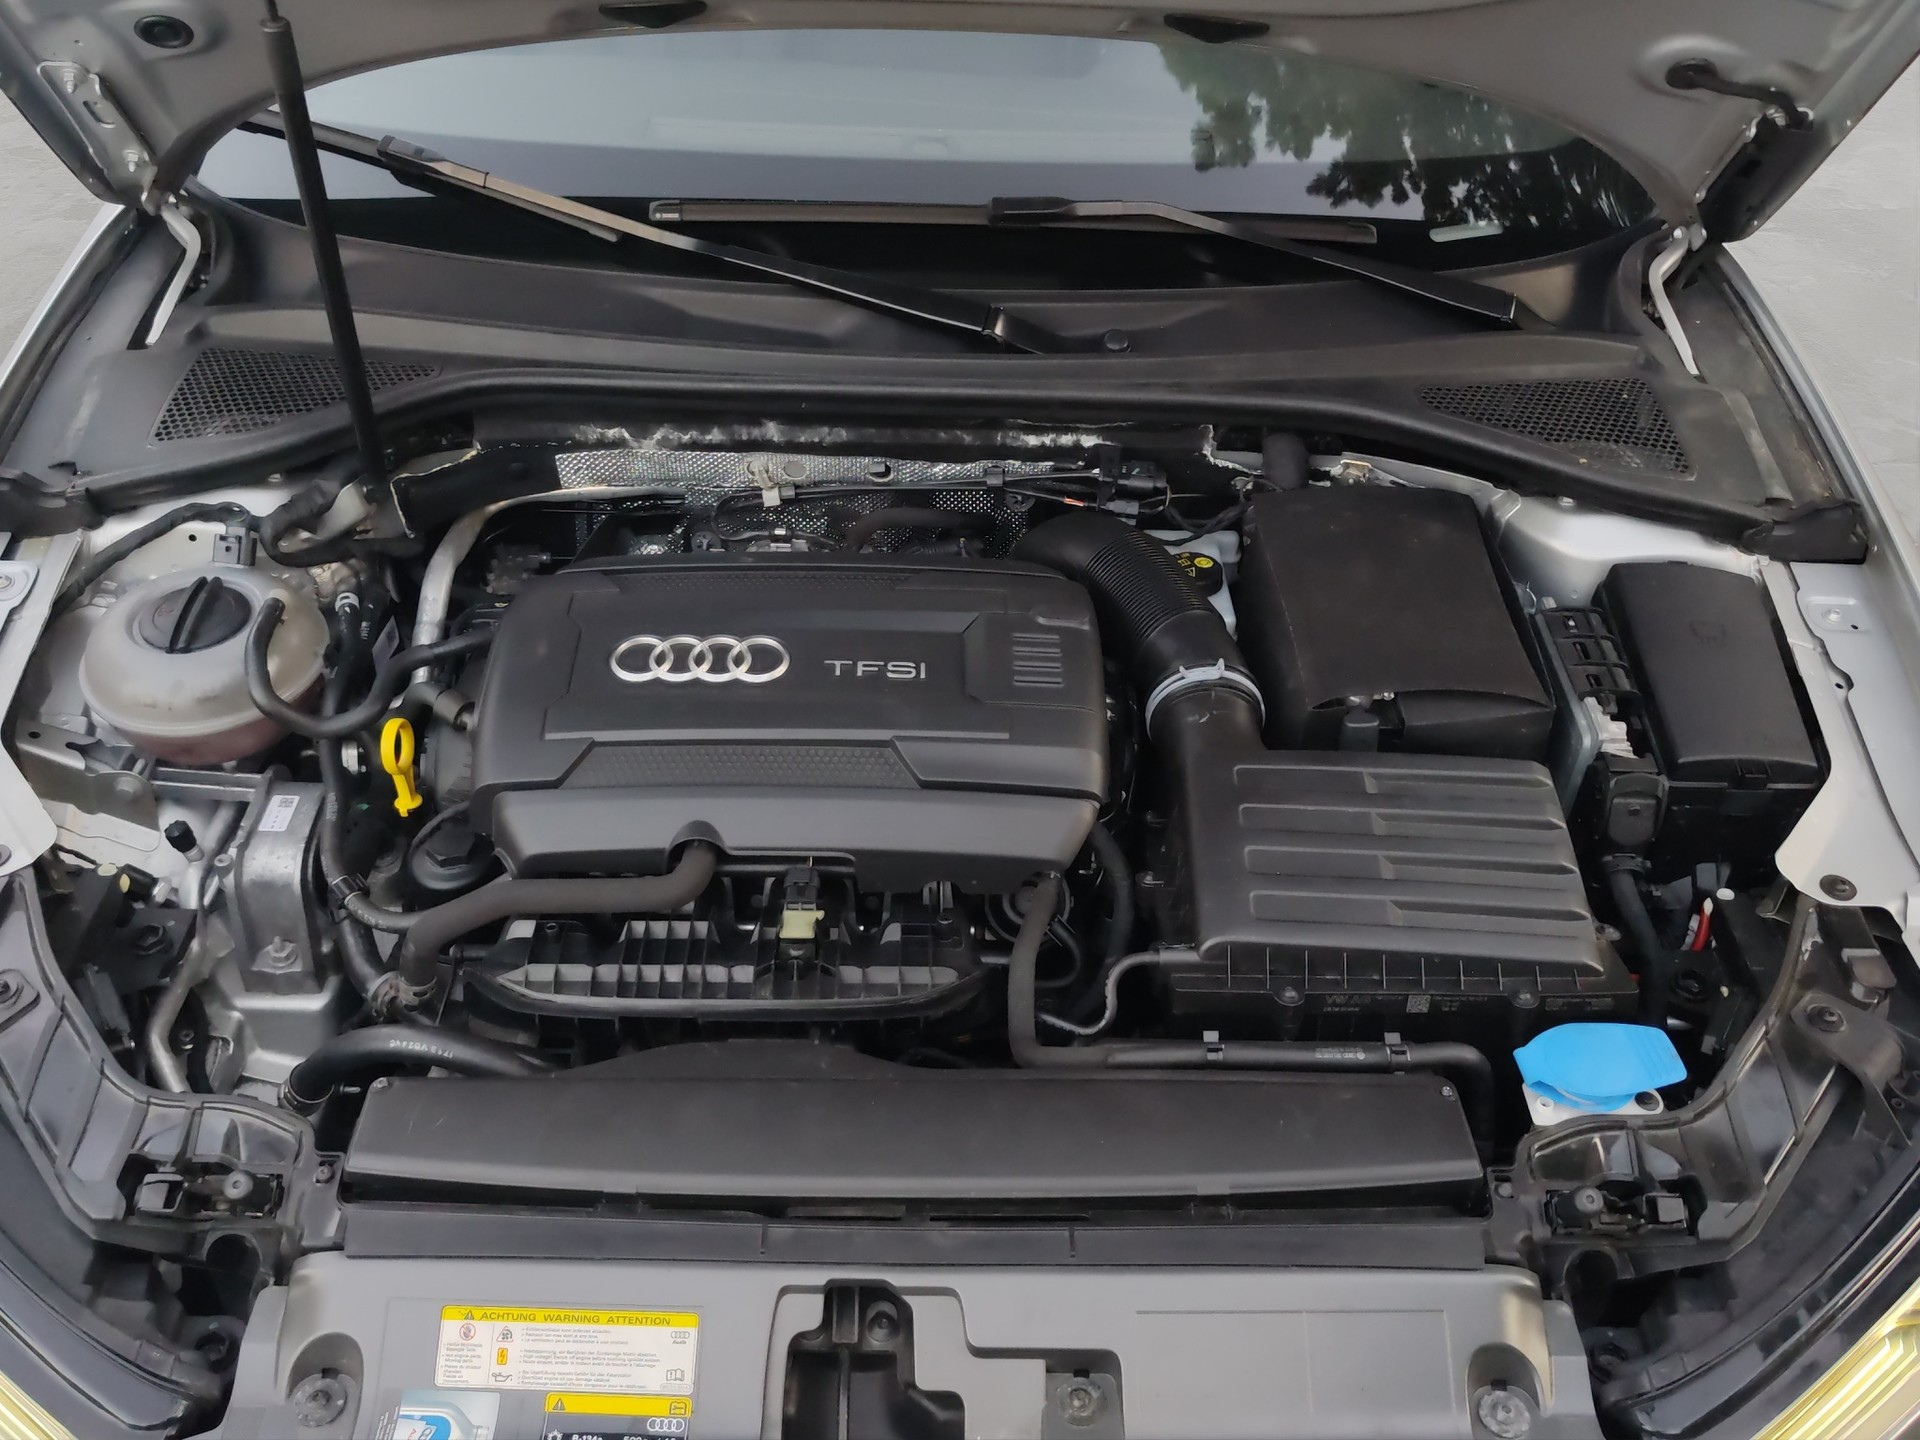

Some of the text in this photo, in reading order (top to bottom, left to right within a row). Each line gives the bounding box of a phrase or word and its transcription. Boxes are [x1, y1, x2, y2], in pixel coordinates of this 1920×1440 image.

[823, 659, 926, 679] TFSI
[480, 1311, 671, 1326] ACHTUNG WARNING ATTENTION
